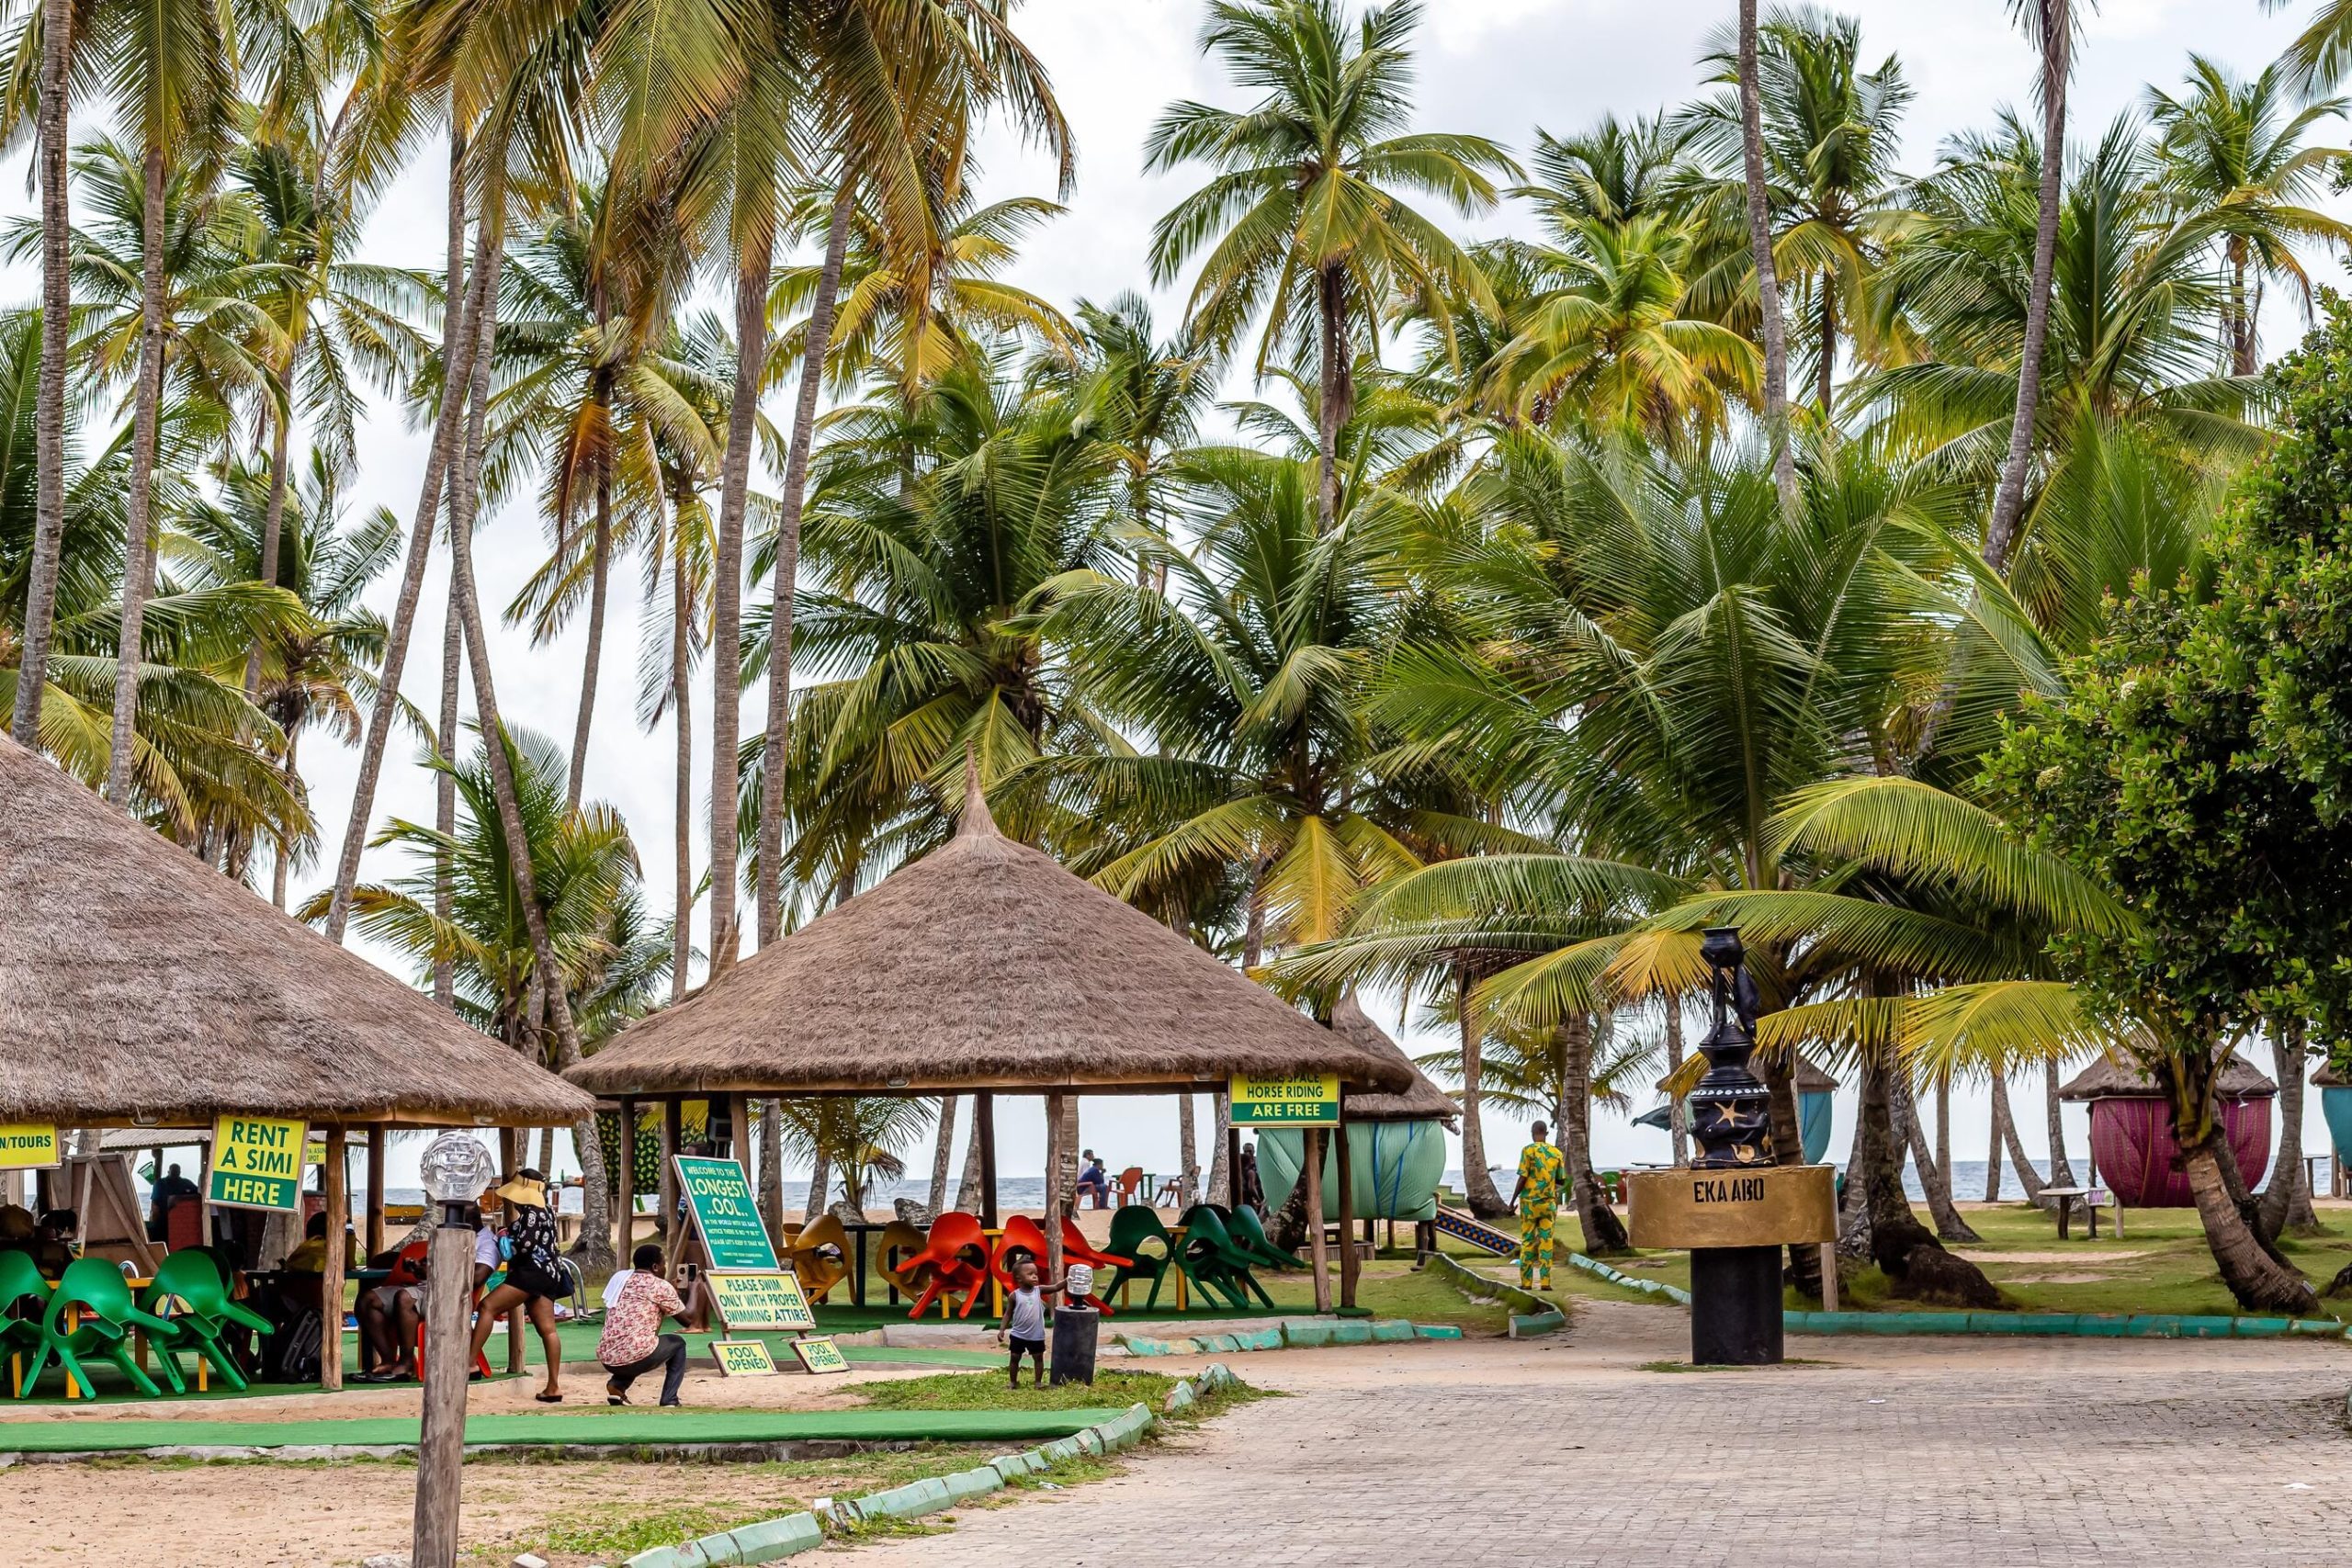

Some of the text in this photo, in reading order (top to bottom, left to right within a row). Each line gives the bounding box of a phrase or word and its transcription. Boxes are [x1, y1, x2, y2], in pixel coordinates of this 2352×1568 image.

[1247, 1086, 1323, 1099] HORSE RIDING
[1252, 1104, 1320, 1117] ARE FREE
[232, 1121, 289, 1147] RENT
[220, 1146, 292, 1174] A SIMI
[686, 1166, 738, 1177] WELCOME TO THE
[223, 1178, 280, 1205] HERE
[687, 1178, 746, 1198] LONGEST
[726, 1279, 783, 1292] PLEASE SWIM
[719, 1293, 801, 1307] ONLY WITH PROPER
[725, 1309, 808, 1322] SWIMMING ATTIRE
[727, 1347, 757, 1359] POOL
[806, 1343, 831, 1354] POOL
[727, 1358, 768, 1371] OPENED
[809, 1354, 841, 1367] OPENED
